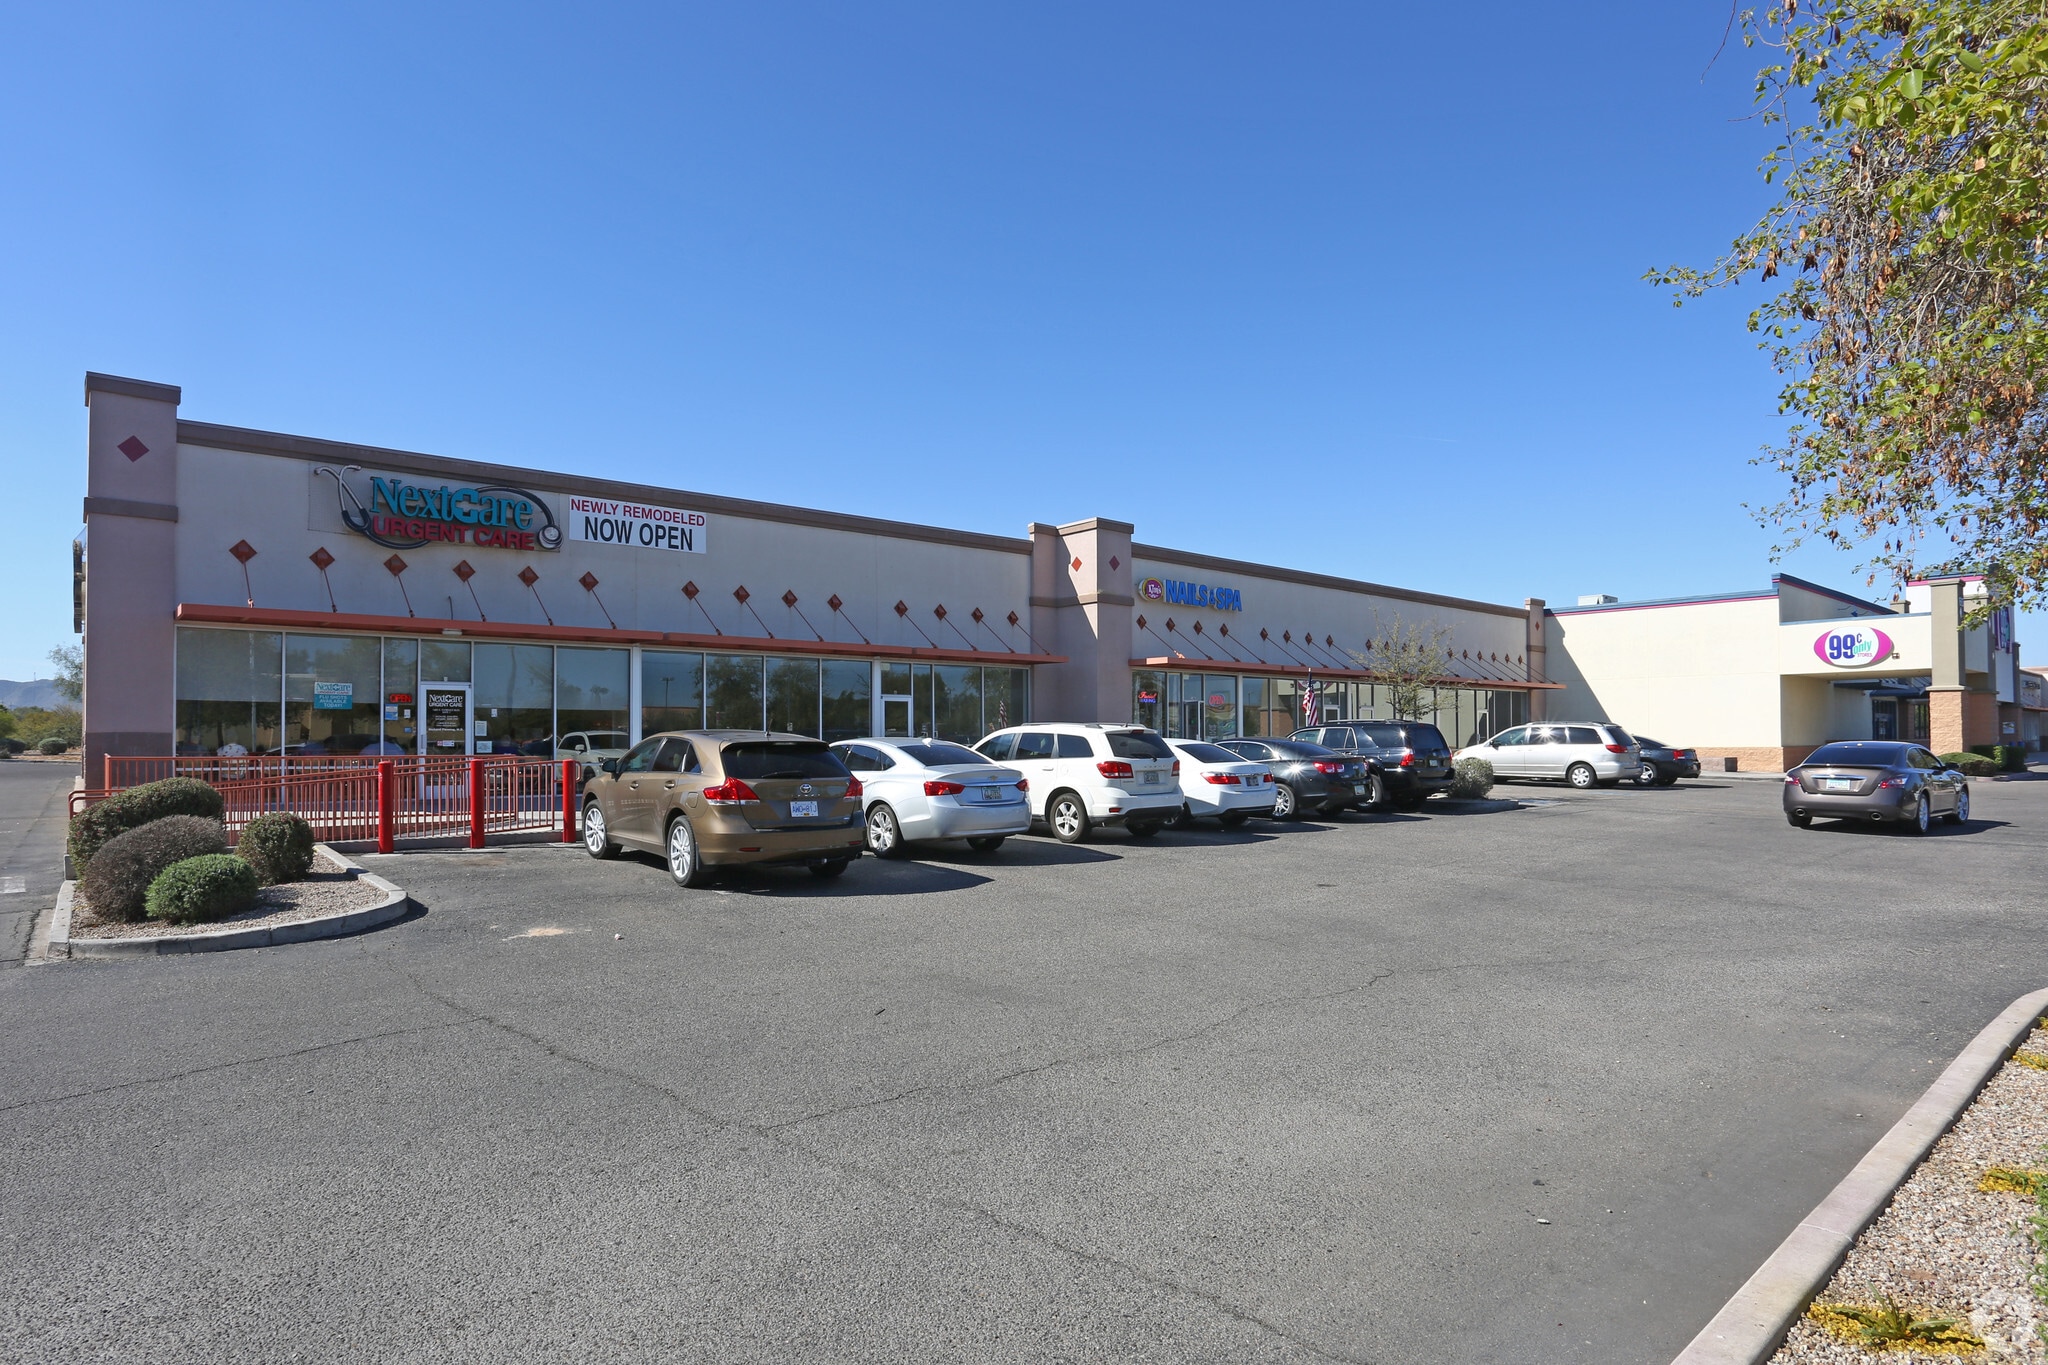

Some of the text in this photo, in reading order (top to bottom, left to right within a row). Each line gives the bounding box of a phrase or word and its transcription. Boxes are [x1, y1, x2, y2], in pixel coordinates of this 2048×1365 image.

[369, 476, 534, 530] NextCare
[571, 498, 705, 527] NEWLY REMODELED
[373, 515, 535, 551] URGENT CARE
[584, 516, 693, 551] NOW OPEN
[1165, 579, 1208, 607] NAILS
[1215, 586, 1242, 612] SPA
[1853, 640, 1872, 655] only
[390, 694, 412, 703] OPEN
[429, 694, 463, 702] NextCare
[1209, 695, 1224, 705] OPEN
